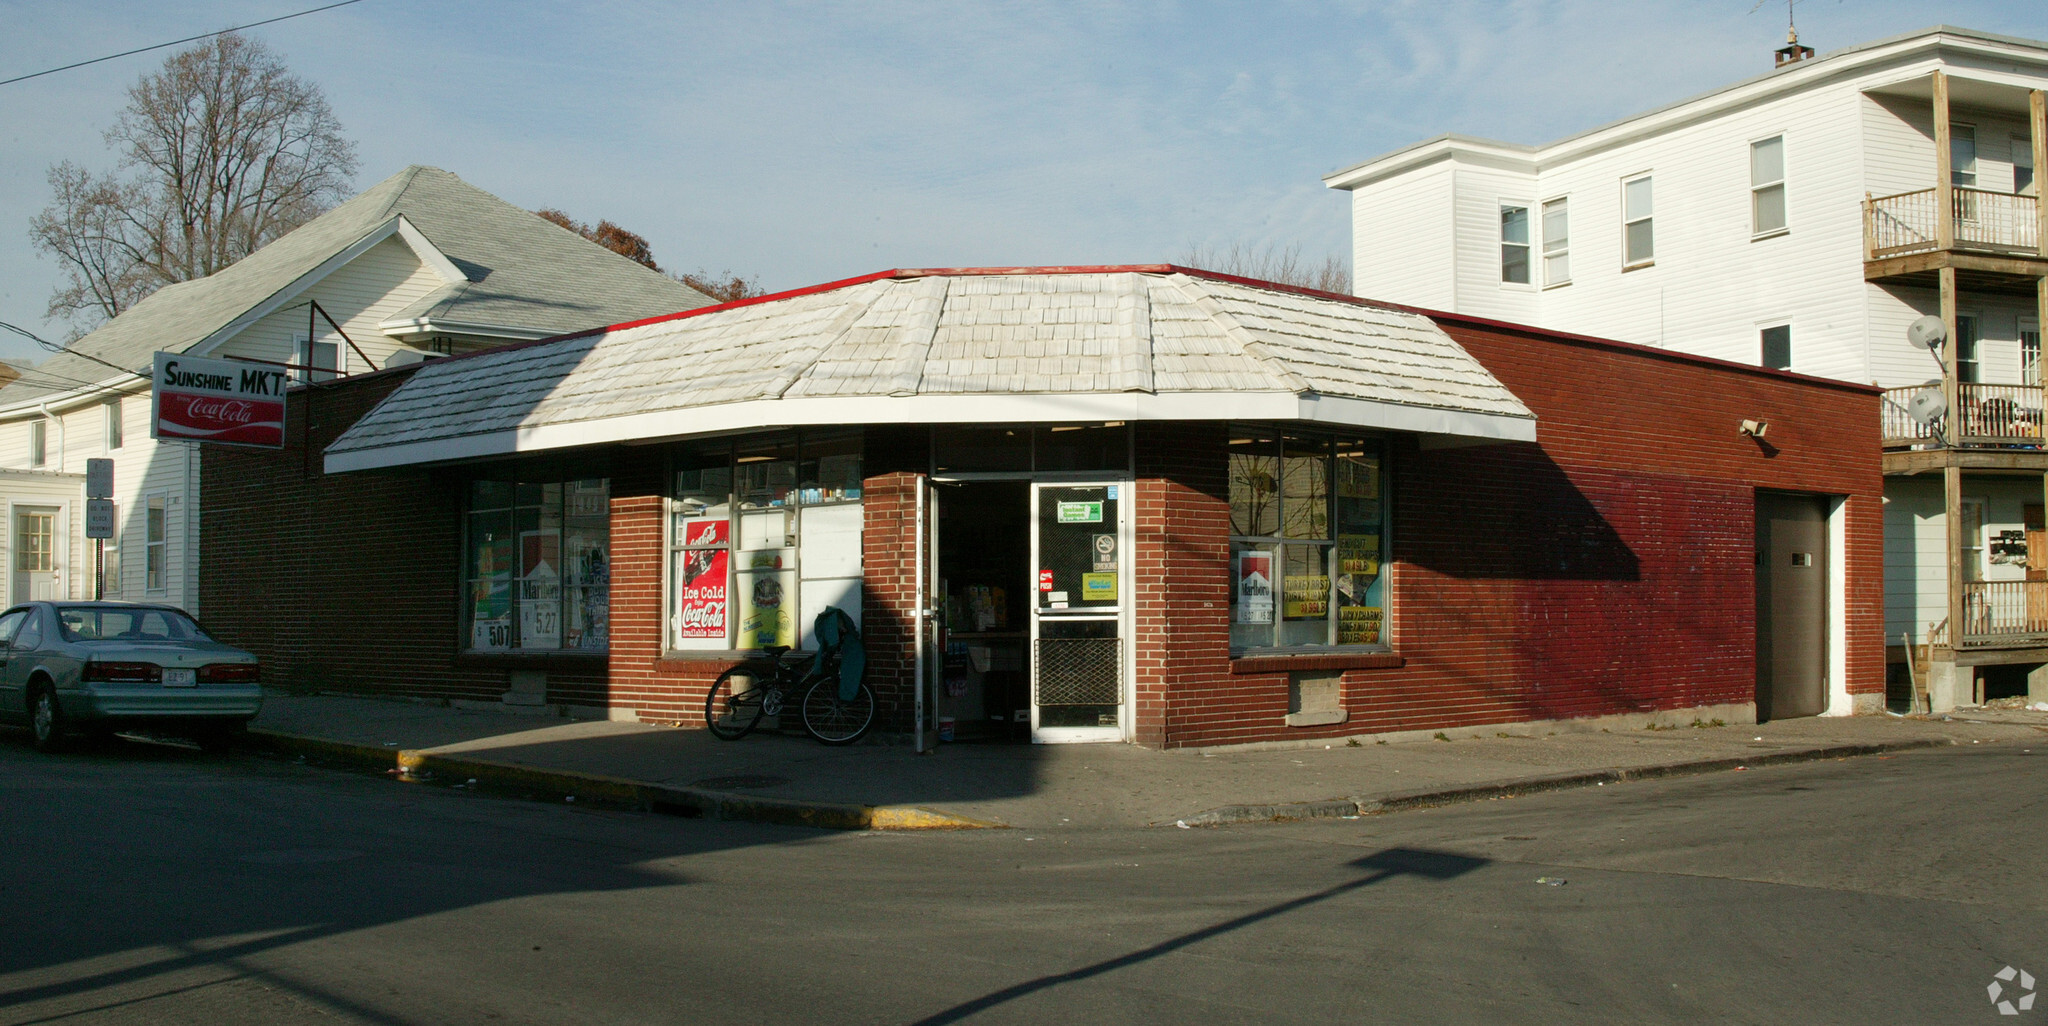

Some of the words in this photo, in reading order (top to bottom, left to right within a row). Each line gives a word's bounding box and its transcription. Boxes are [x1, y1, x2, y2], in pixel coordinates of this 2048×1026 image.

[240, 369, 284, 397] MKT.
[1100, 554, 1111, 562] NO
[683, 587, 699, 599] Ice
[701, 586, 724, 599] Cold
[1241, 579, 1270, 597] Marlboro
[535, 612, 556, 634] 5.27
[683, 601, 725, 628] Coca-Cola
[1358, 610, 1384, 621] CHARMS
